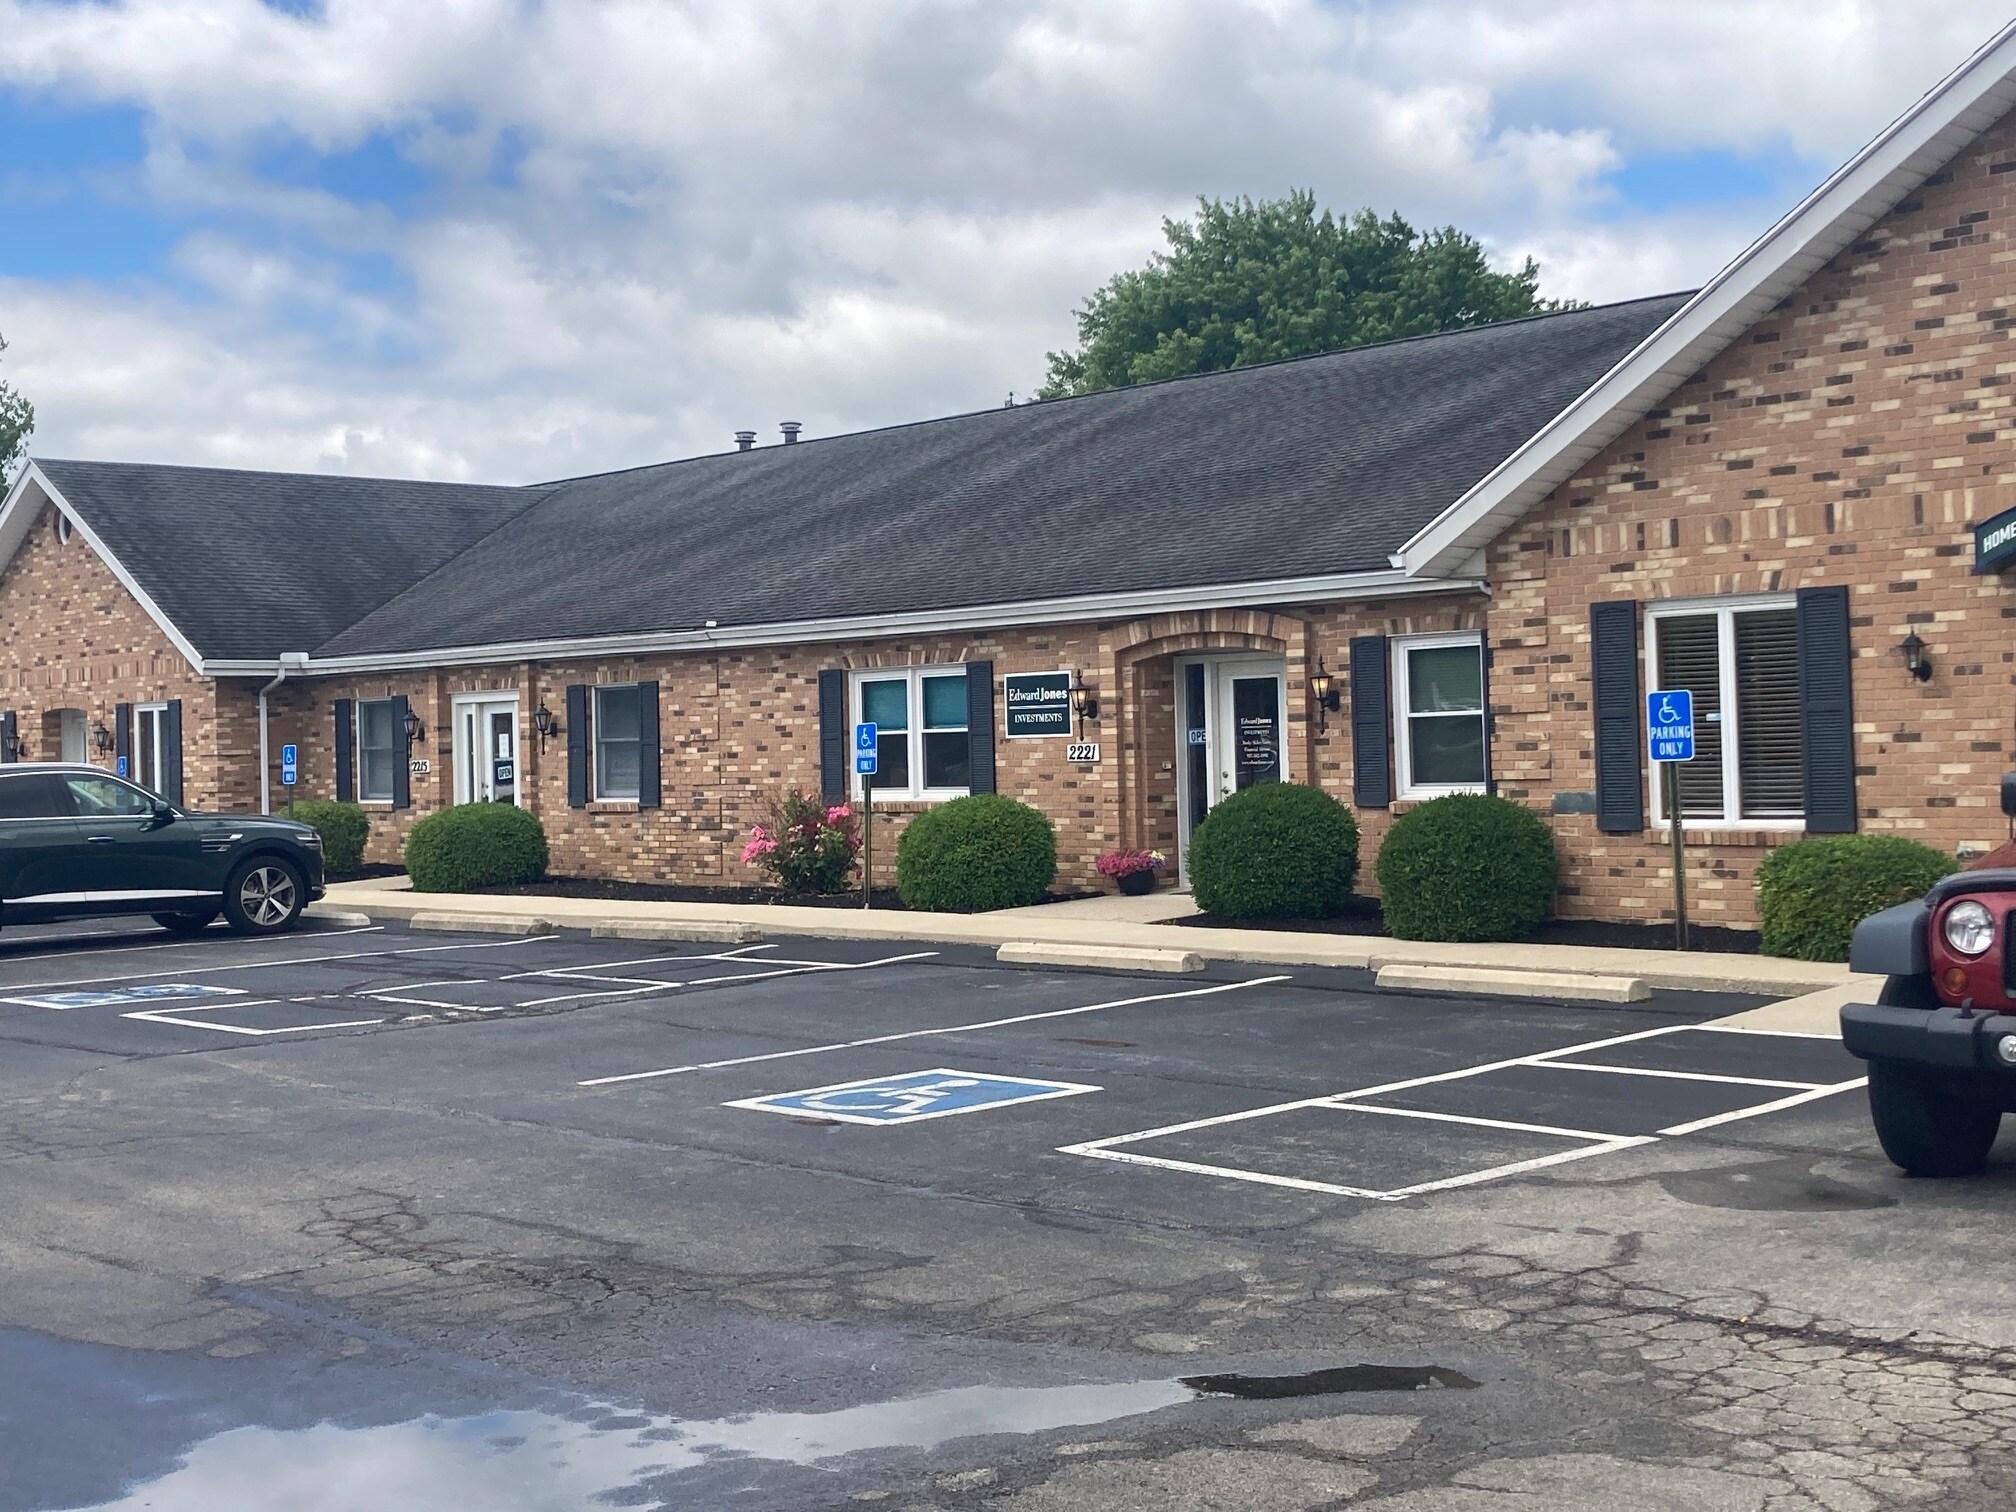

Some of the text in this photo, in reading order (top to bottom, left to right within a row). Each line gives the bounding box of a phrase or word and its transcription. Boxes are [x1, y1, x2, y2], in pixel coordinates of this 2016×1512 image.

[1983, 521, 2016, 553] HOME
[1014, 713, 1063, 723] INVESTMENTS
[1650, 725, 1691, 740] PARKING
[1069, 744, 1096, 760] 2221
[1659, 741, 1684, 756] ONLY
[412, 761, 428, 772] 2215
[499, 767, 511, 778] OPEN
